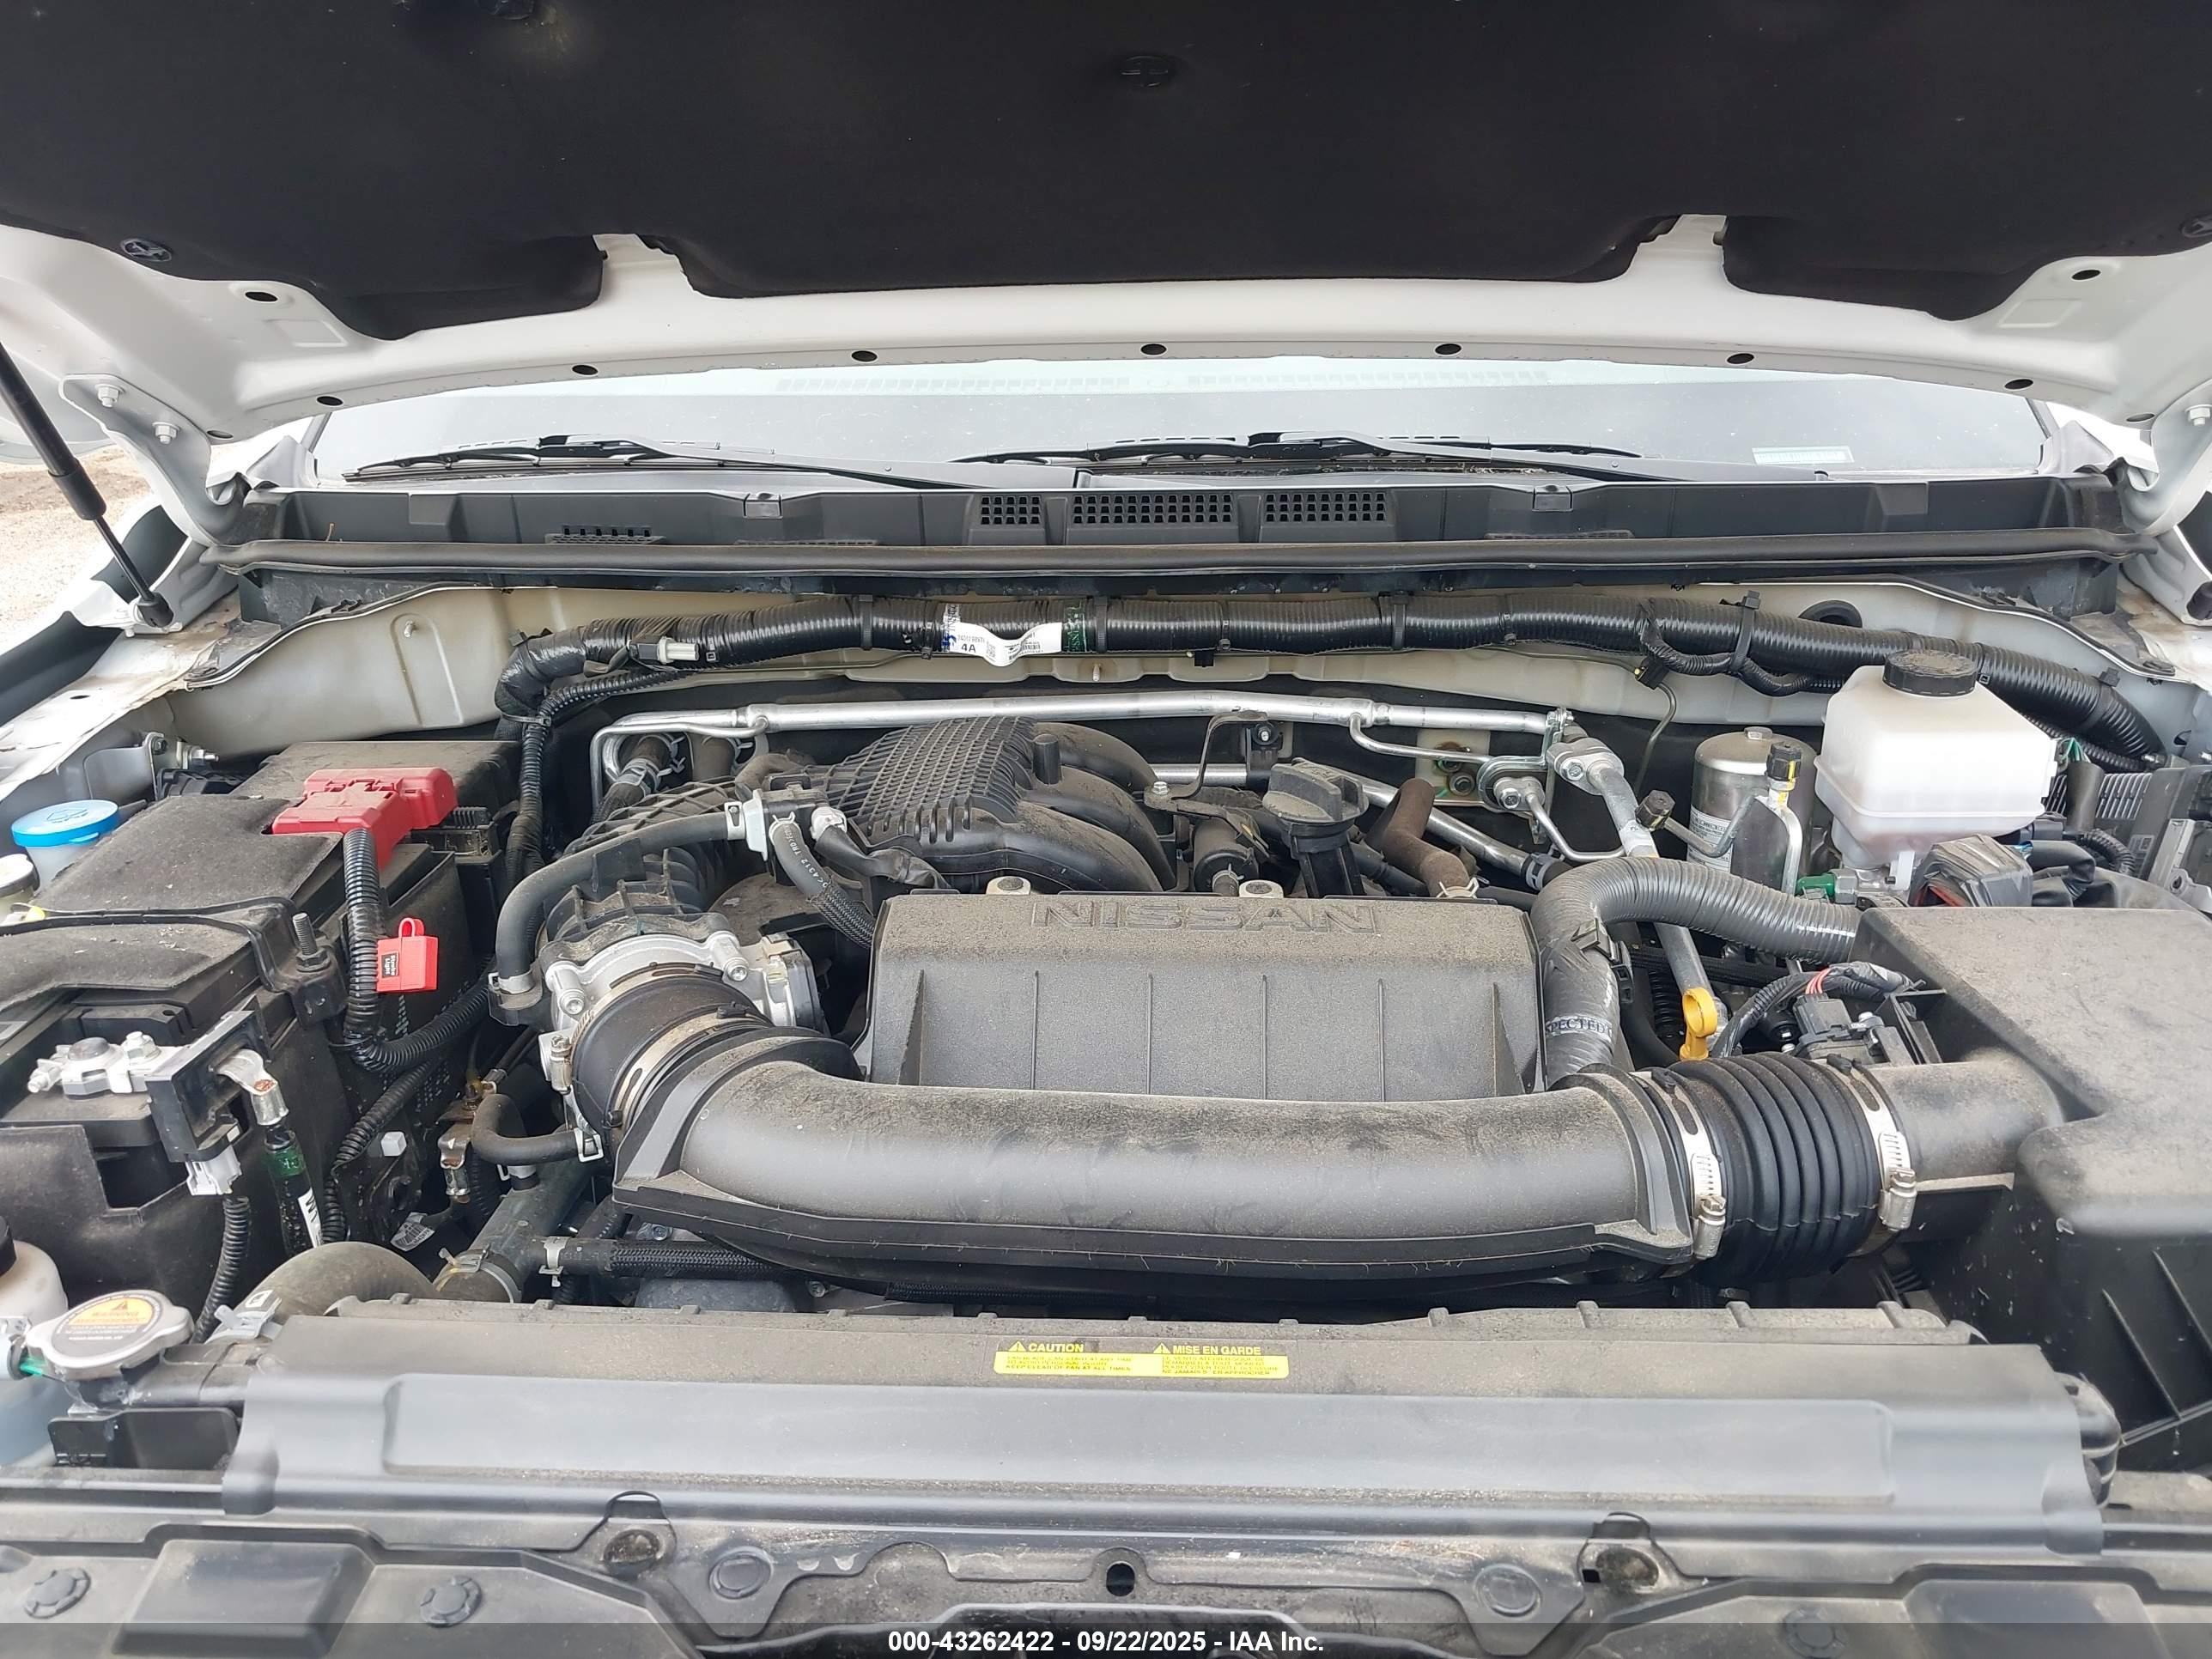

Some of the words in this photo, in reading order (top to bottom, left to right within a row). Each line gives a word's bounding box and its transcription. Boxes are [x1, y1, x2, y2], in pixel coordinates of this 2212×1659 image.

[961, 643, 976, 653] 4A
[1030, 901, 1376, 934] NISSAN
[1028, 1343, 1085, 1352] CAUTION
[1172, 1345, 1200, 1354] MISE
[1202, 1346, 1218, 1355] EN
[1220, 1346, 1262, 1355] GARDE
